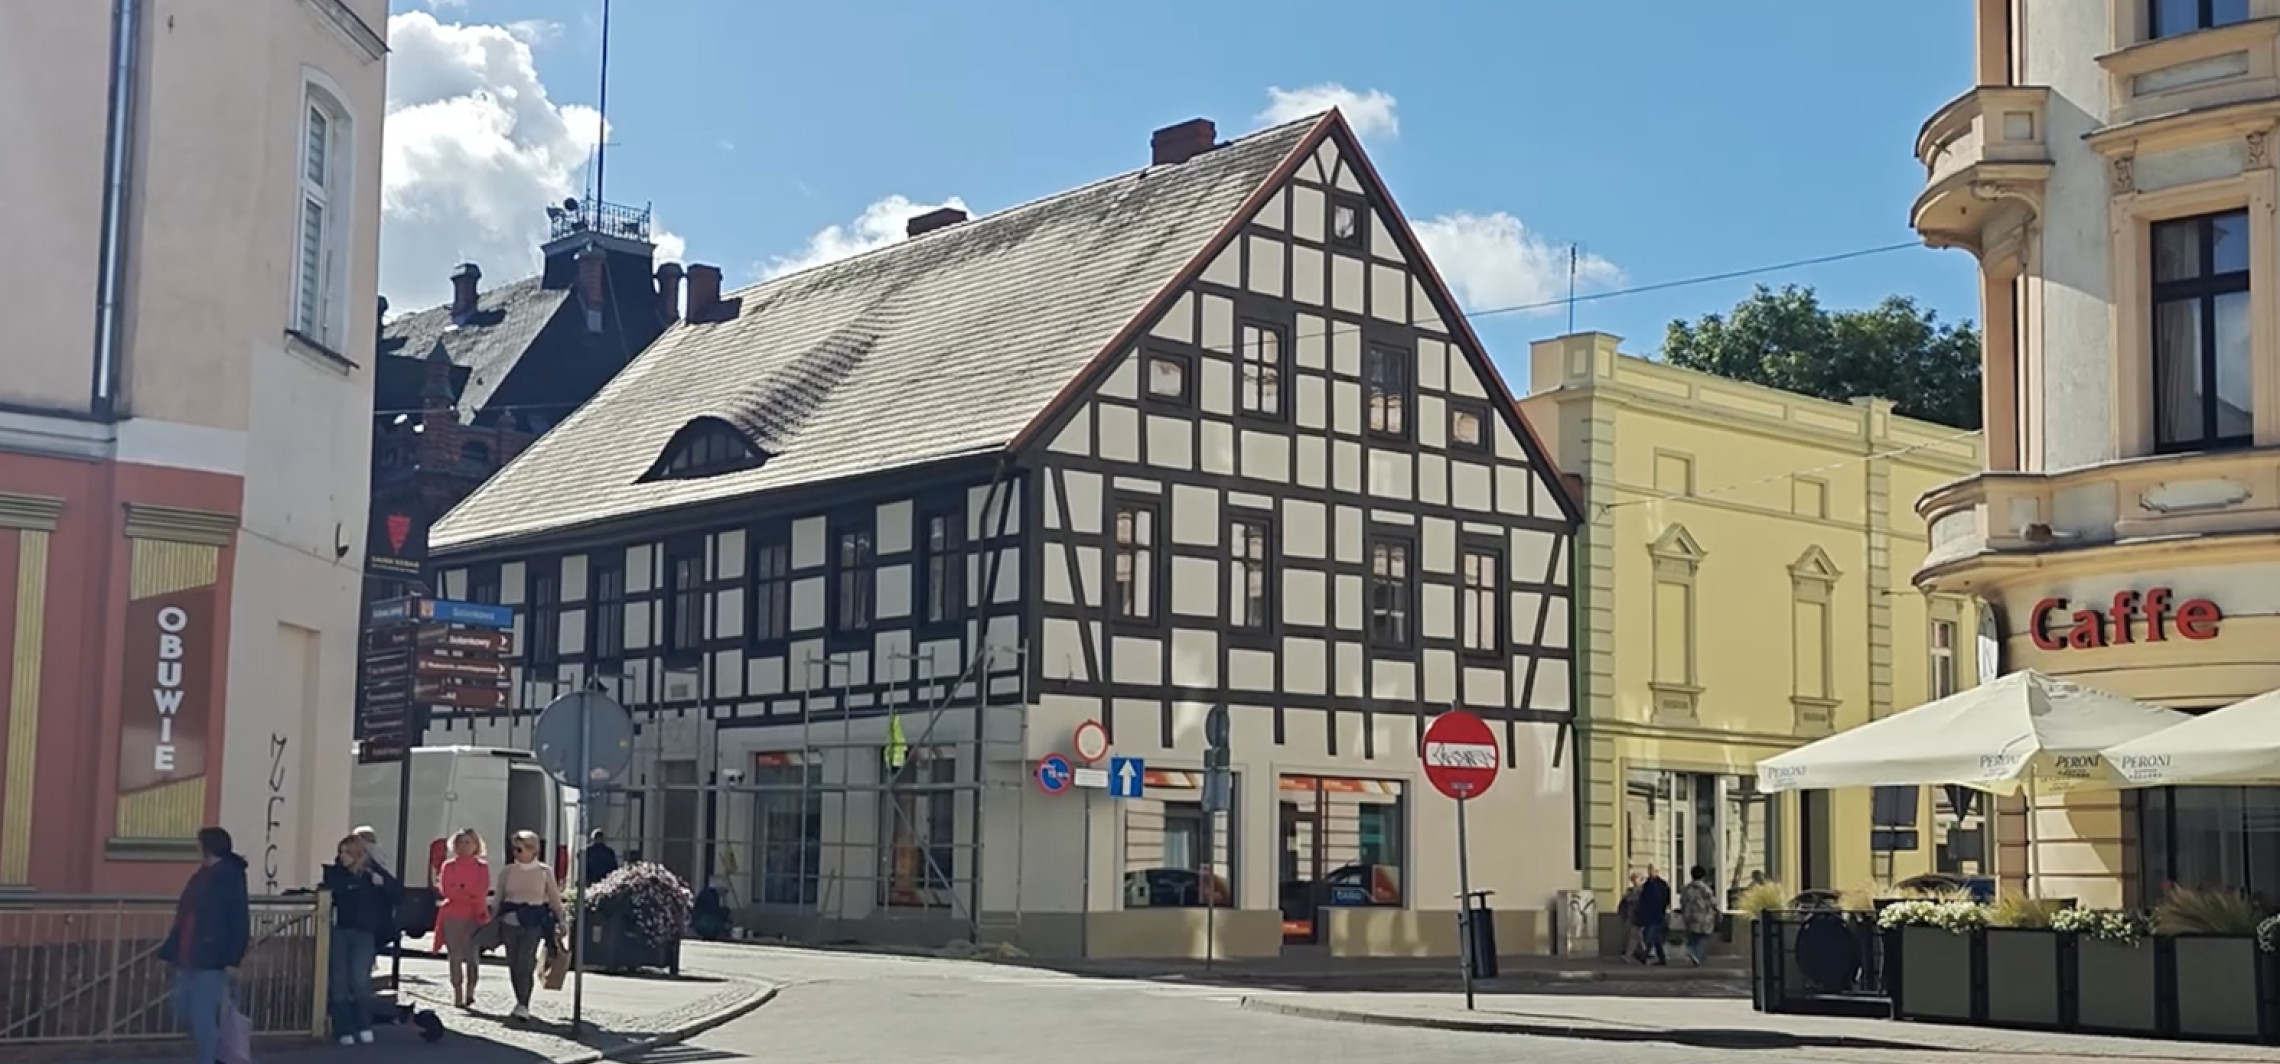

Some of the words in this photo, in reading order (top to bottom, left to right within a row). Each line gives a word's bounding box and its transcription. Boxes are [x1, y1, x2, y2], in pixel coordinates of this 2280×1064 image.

[2030, 586, 2223, 651] Caffe
[152, 606, 189, 771] OBUWIE
[2055, 753, 2101, 769] PERONI
[2121, 754, 2171, 770] PERONI
[1767, 765, 1806, 780] PERONI
